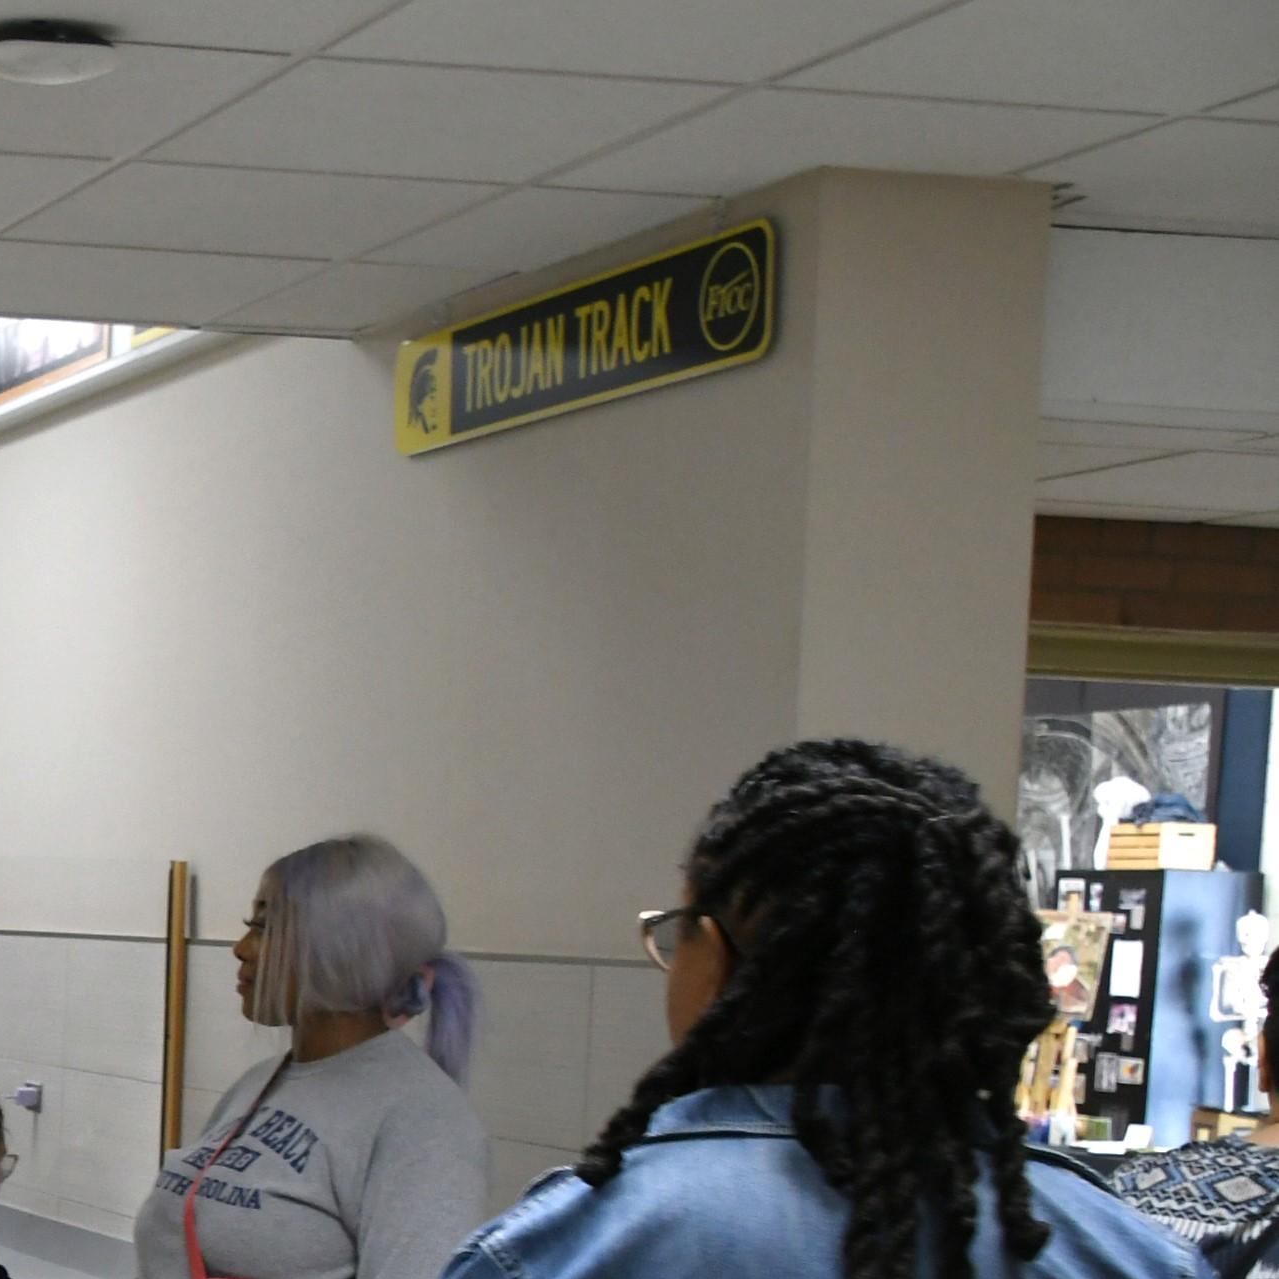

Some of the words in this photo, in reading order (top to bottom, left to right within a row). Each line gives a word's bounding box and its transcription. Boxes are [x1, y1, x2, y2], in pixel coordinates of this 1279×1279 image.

[463, 313, 566, 413] TROJAN
[575, 277, 673, 380] TRACK
[195, 1177, 261, 1210] ROLINA
